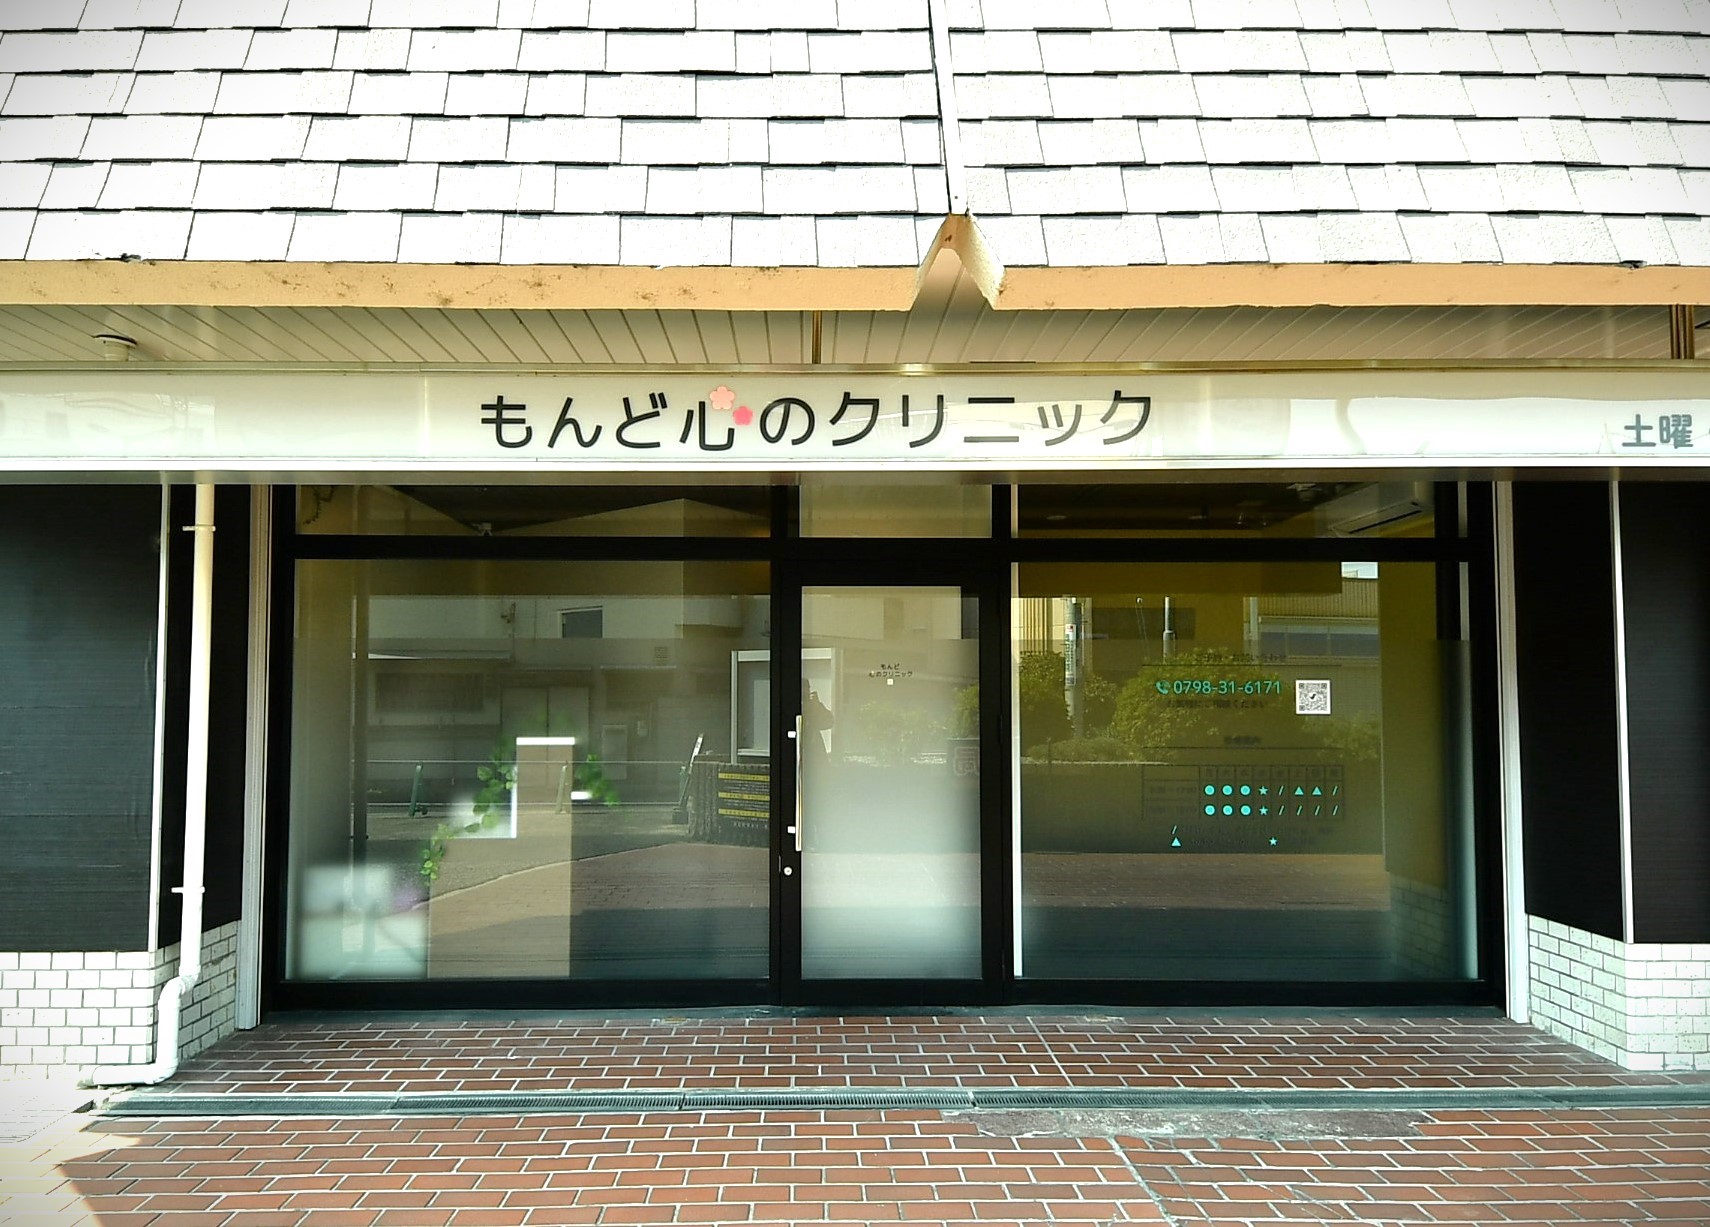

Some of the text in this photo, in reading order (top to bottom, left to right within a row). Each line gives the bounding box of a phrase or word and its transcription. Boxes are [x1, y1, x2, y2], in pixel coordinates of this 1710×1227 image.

[481, 390, 1151, 450] もんど心のクリニック
[1173, 680, 1281, 695] 0798-31-6171
